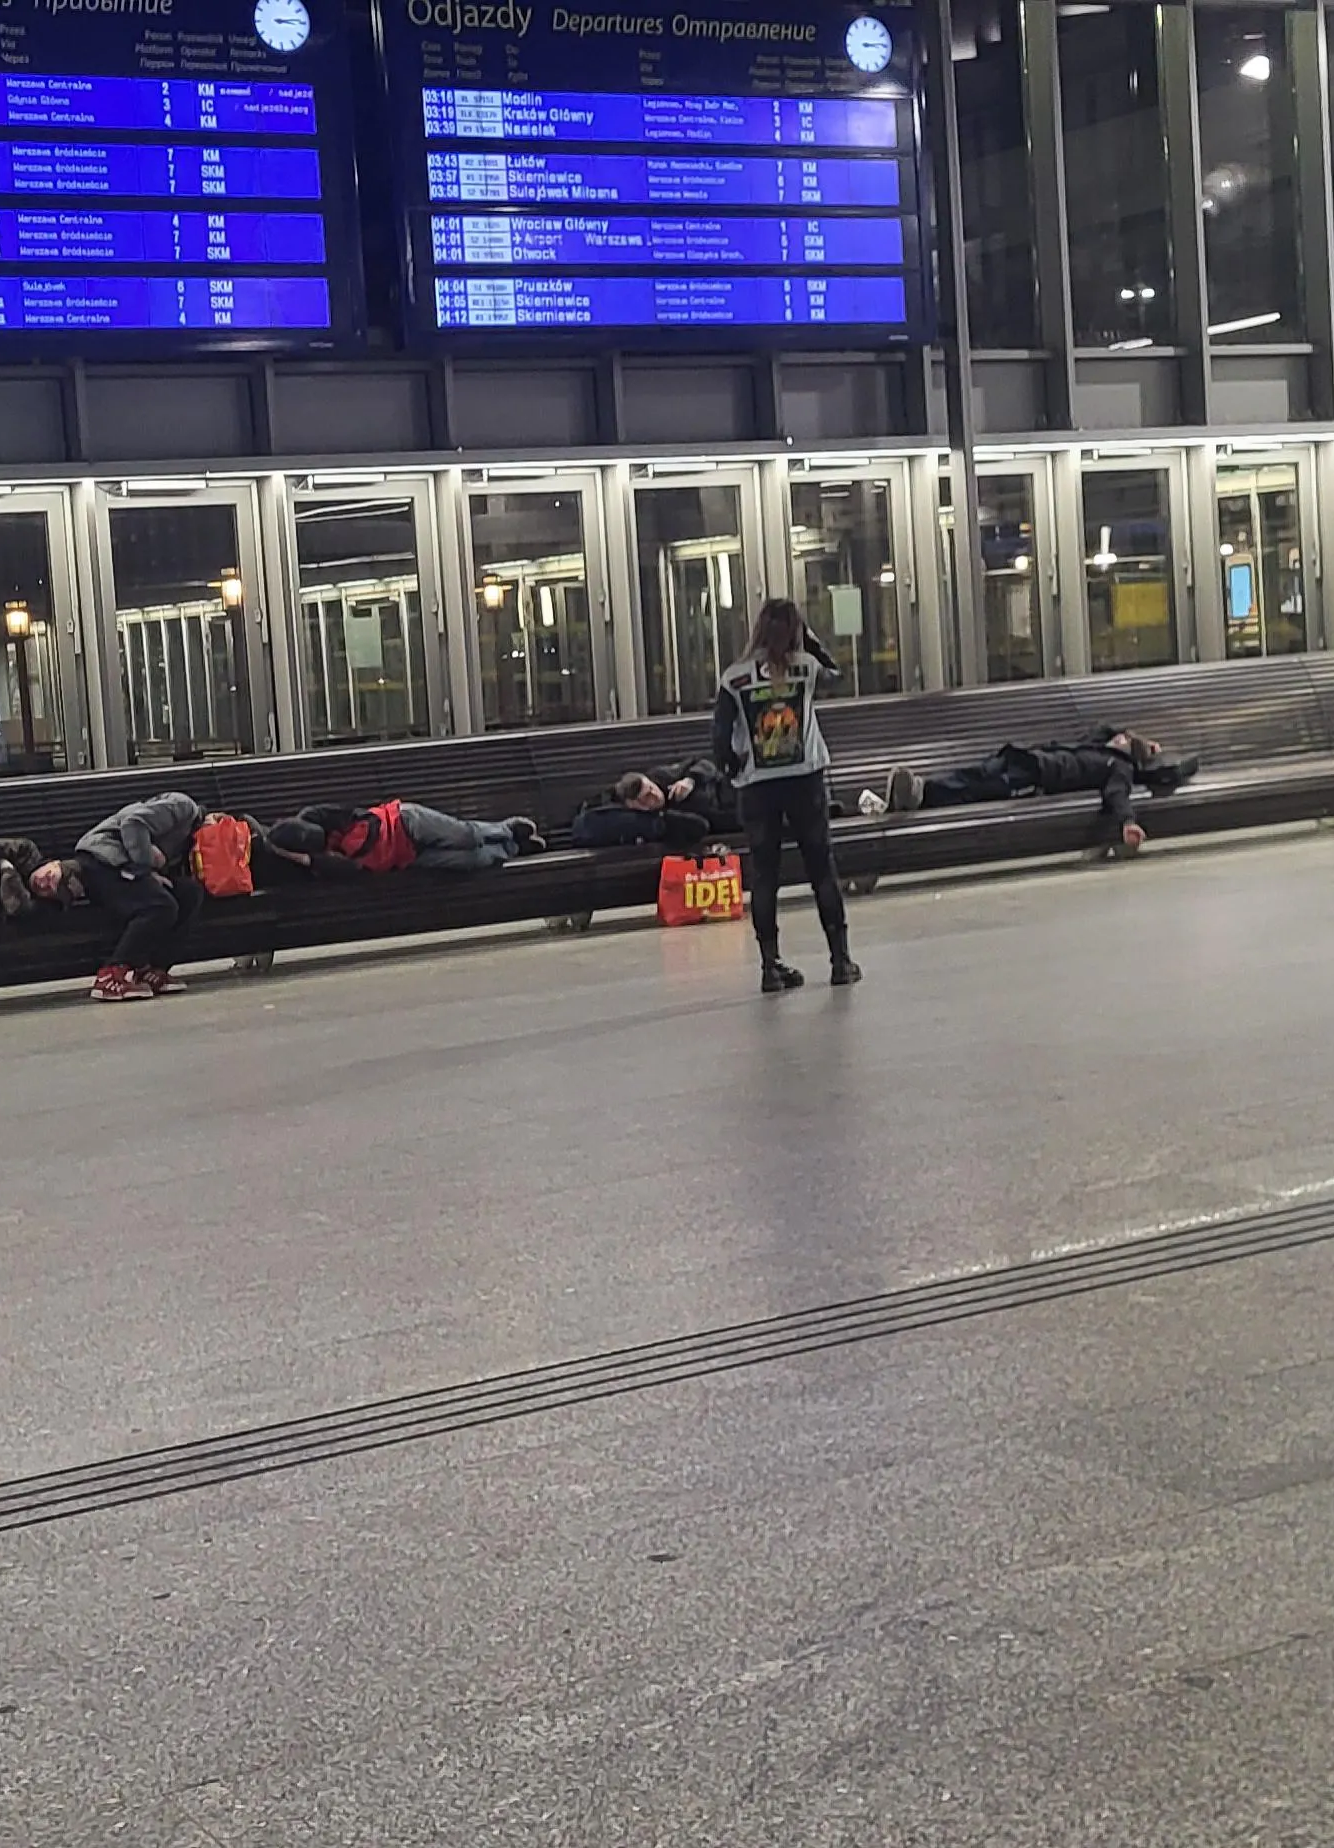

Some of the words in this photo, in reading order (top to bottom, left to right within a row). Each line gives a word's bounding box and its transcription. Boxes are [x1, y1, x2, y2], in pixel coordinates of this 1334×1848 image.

[408, 0, 532, 38] Odjazdy
[553, 9, 664, 36] Departures
[672, 14, 817, 43] Отправление
[162, 82, 169, 96] 2
[198, 83, 215, 97] KM
[163, 98, 171, 112] 3
[201, 99, 213, 112] IC
[503, 92, 543, 106] Modlin
[799, 102, 813, 113] KM
[164, 114, 171, 127] 4
[200, 115, 217, 128] KM
[504, 107, 547, 121] Kraków
[549, 108, 594, 126] Główny
[801, 116, 813, 128] IC
[505, 122, 556, 137] Nasielsk
[801, 130, 815, 142] KM
[167, 148, 173, 161] 7
[203, 149, 220, 162] KM
[168, 164, 175, 178] 7
[201, 165, 225, 178] SKM
[507, 154, 547, 168] Łuków
[803, 162, 817, 174] KM
[431, 170, 457, 183] 03:57
[508, 170, 583, 184] Skierniewice
[803, 176, 817, 188] KM
[169, 180, 175, 194] 7
[202, 181, 226, 194] SKM
[509, 185, 569, 201] Sulejówek
[571, 186, 619, 200] Miłosna
[801, 190, 821, 202] SKM
[173, 214, 179, 228] 4
[208, 215, 225, 228] KM
[434, 218, 460, 230] 04:01
[511, 218, 563, 230] Wrocław
[564, 218, 609, 234] Główny
[808, 221, 819, 232] IC
[173, 230, 179, 244] 7
[209, 231, 225, 244] KM
[435, 232, 461, 246] 04:01
[584, 233, 643, 246] Warszawa
[805, 235, 824, 248] SKM
[174, 246, 181, 260] 7
[207, 246, 231, 260] SKM
[436, 247, 462, 260] 04:01
[513, 247, 557, 260] Otwock
[805, 250, 825, 261] SKM
[177, 280, 185, 294] 6
[209, 280, 233, 294] SKM
[515, 279, 573, 292] Pruszków
[807, 280, 827, 292] SKM
[178, 296, 184, 309] 7
[211, 296, 234, 309] SKM
[516, 294, 590, 308] Skierniewice
[179, 312, 186, 325] 4
[215, 312, 231, 325] KM
[441, 310, 467, 324] 04:12
[517, 308, 591, 322] Skierniewice
